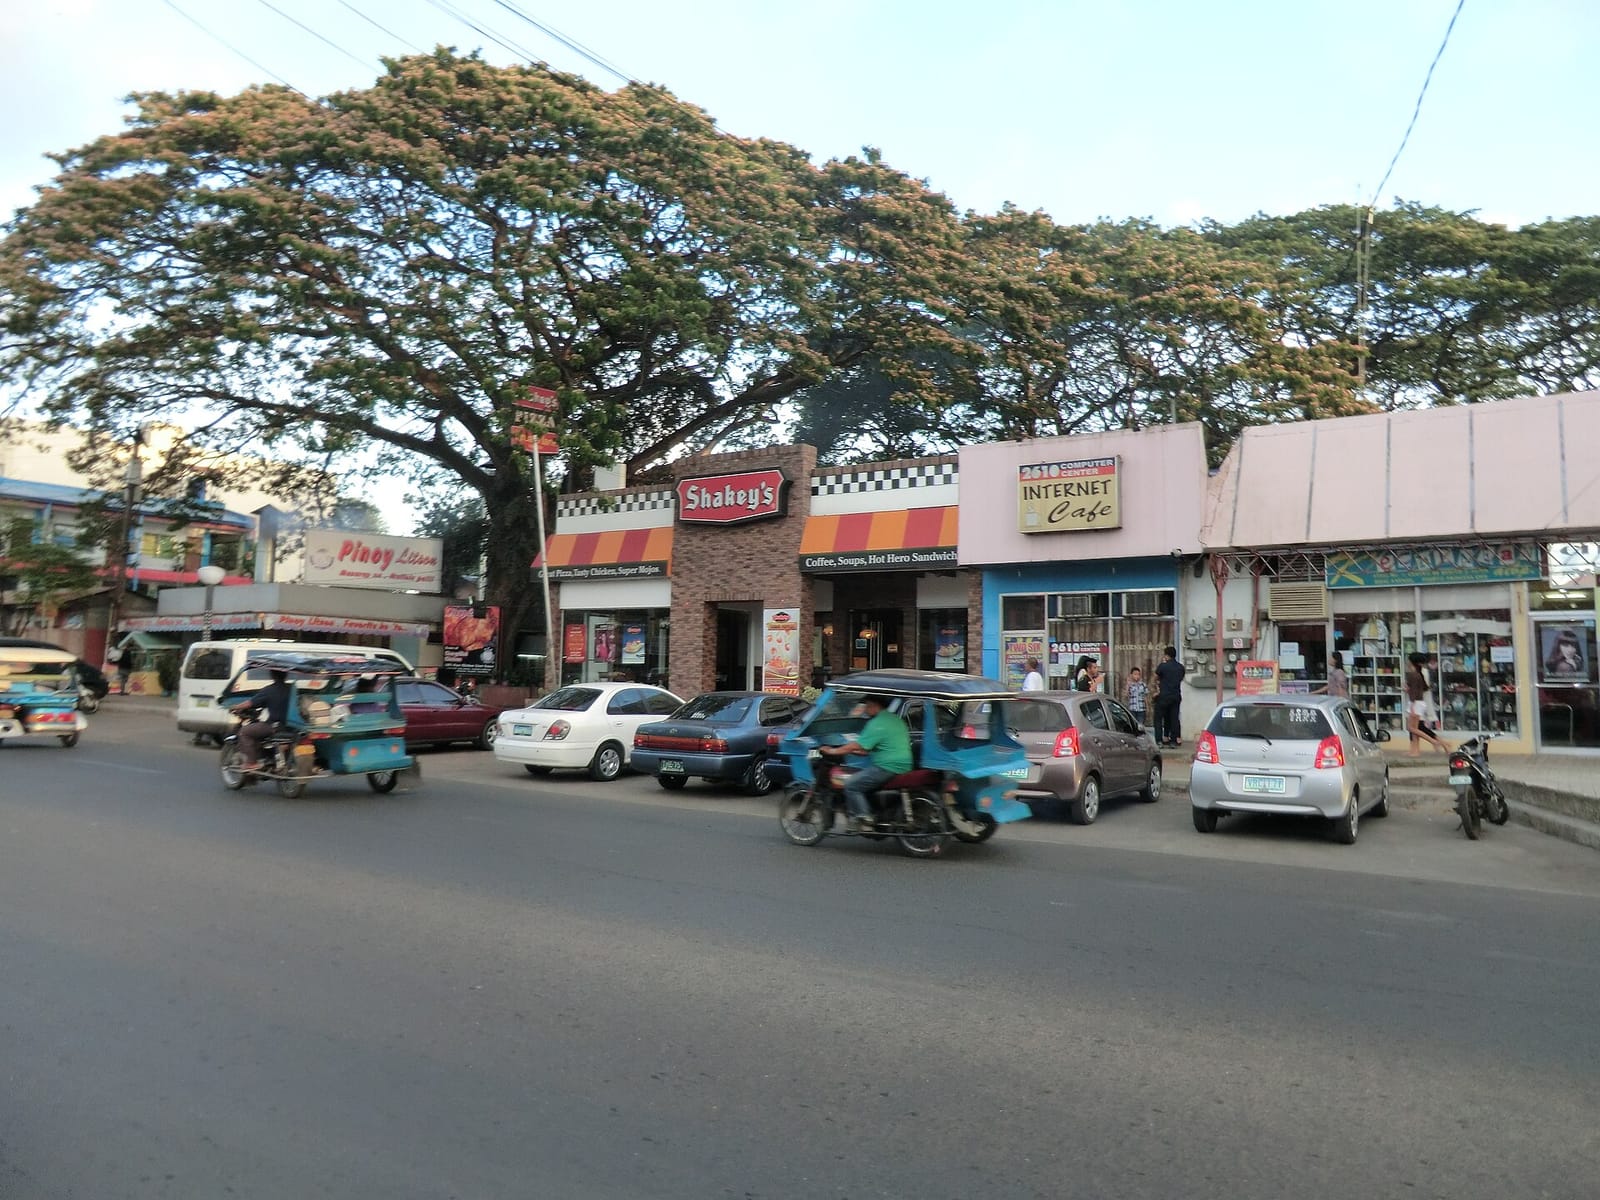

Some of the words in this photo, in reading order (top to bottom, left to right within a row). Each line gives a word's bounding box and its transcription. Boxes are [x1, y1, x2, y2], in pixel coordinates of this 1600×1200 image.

[1021, 464, 1060, 479] 2610
[1060, 459, 1113, 469] COMPUTER
[1060, 467, 1098, 477] CENTER
[685, 481, 774, 510] Shakey's
[1023, 479, 1111, 500] INTERNET
[1047, 500, 1112, 523] Cafe
[338, 540, 394, 571] Pinoy
[805, 557, 837, 567] Coffee,
[838, 556, 867, 566] Soups,
[869, 554, 885, 564] Hot
[887, 553, 910, 563] Hero
[1051, 642, 1080, 653] 2610
